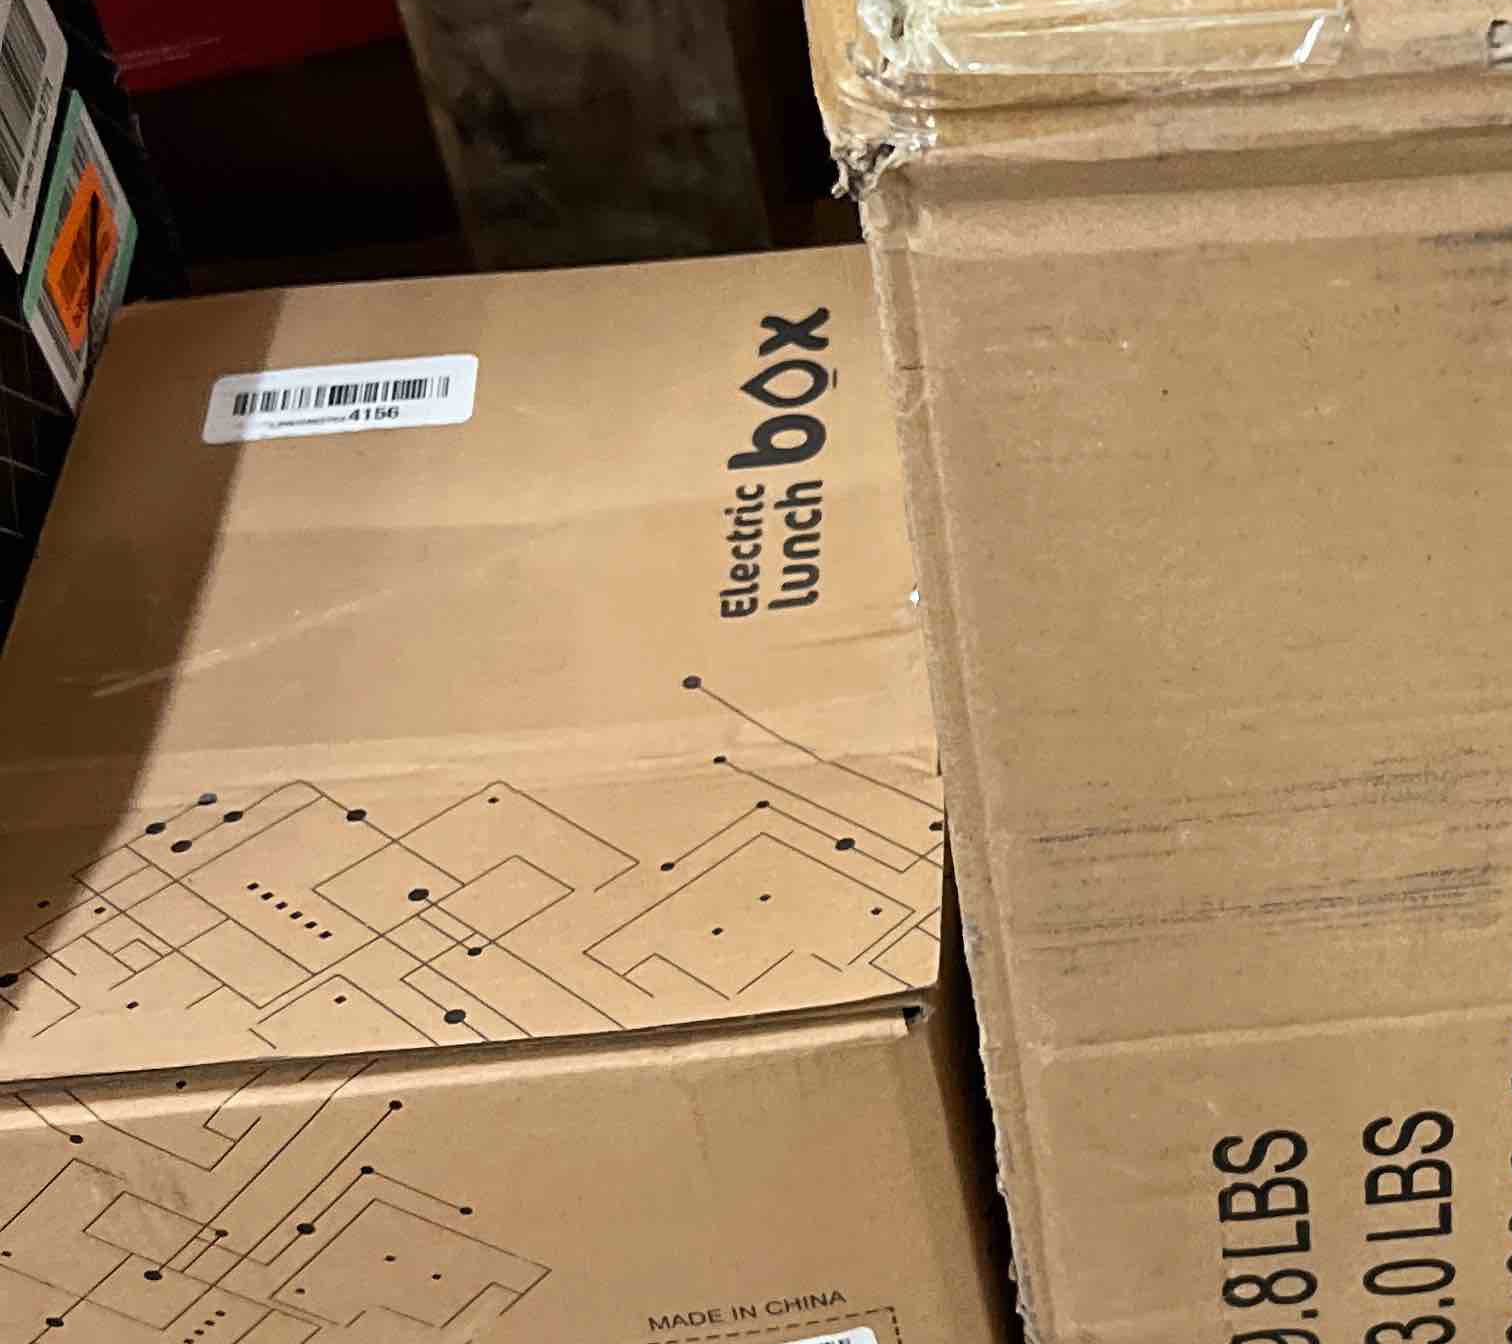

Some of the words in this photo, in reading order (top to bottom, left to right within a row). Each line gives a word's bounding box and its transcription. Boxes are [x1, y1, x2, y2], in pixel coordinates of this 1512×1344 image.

[719, 481, 768, 620] Electric
[767, 478, 825, 611] lunch
[647, 1308, 727, 1333] MADE
[731, 1304, 758, 1324] IN
[762, 1288, 849, 1318] CHINA
